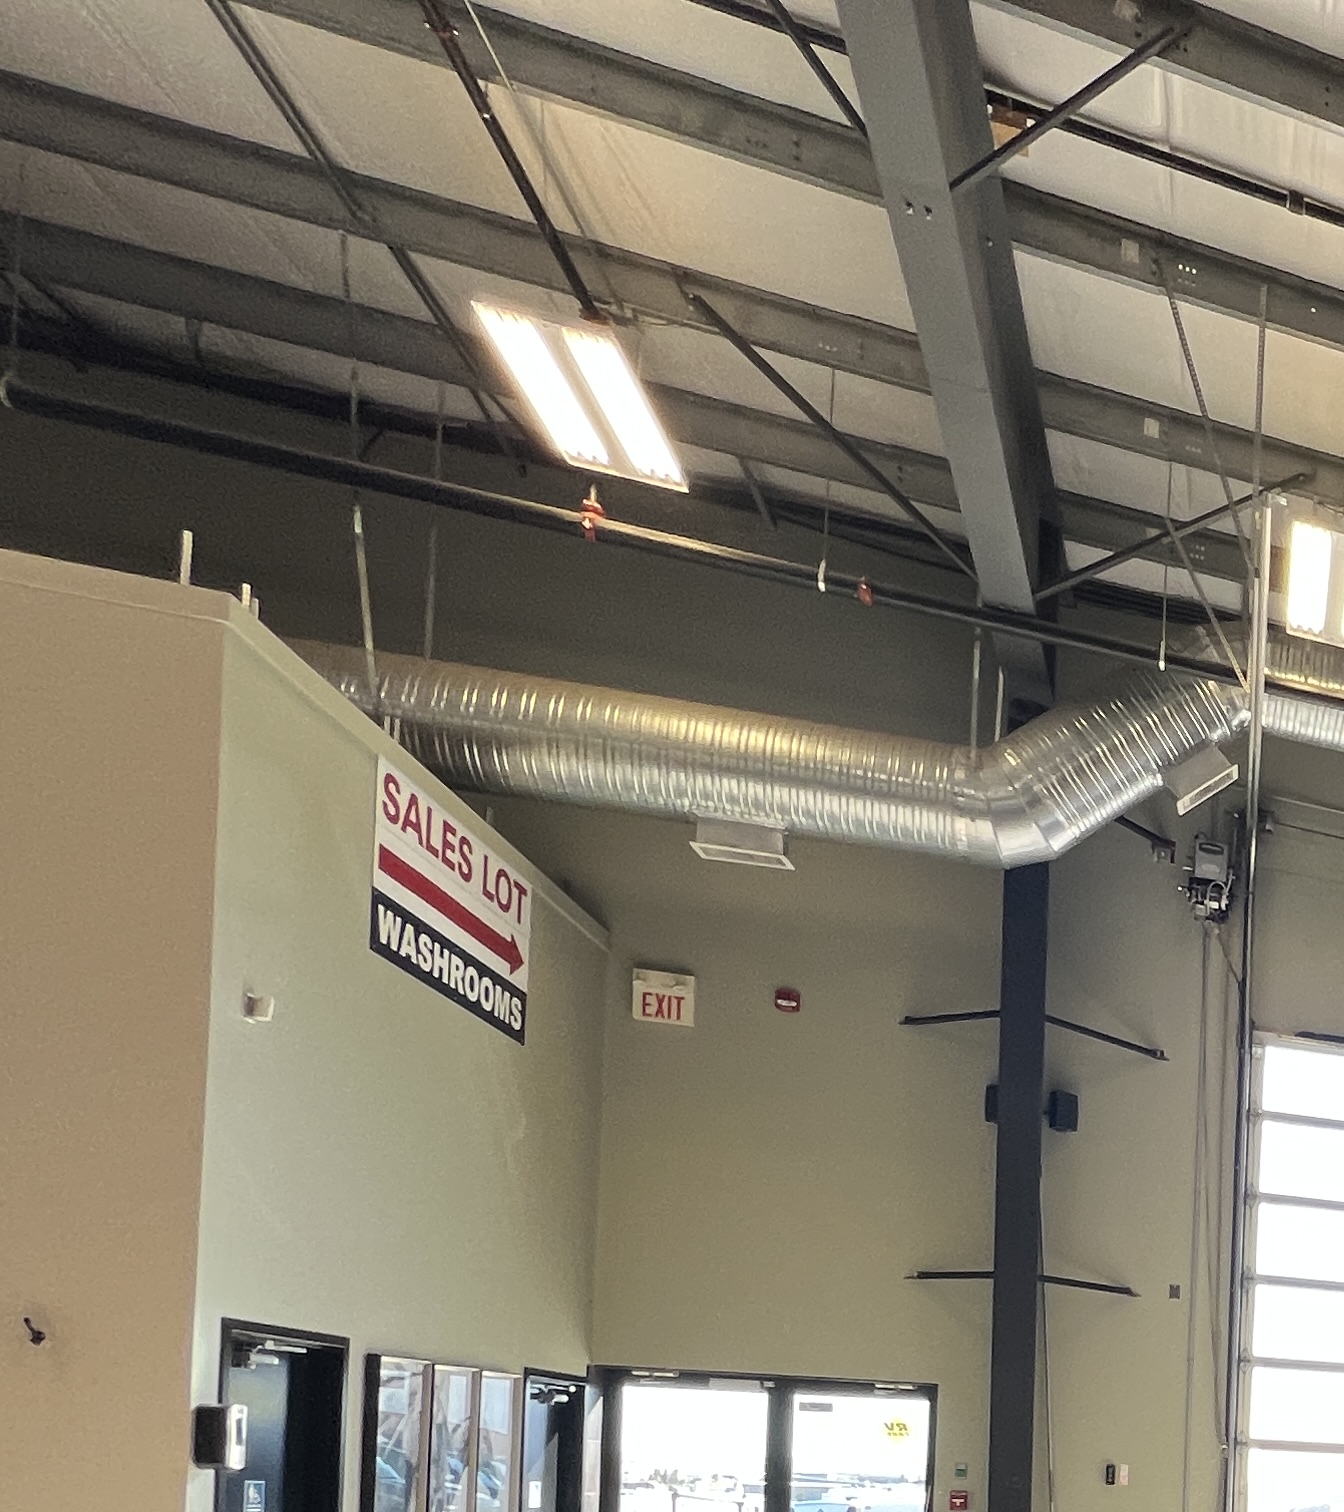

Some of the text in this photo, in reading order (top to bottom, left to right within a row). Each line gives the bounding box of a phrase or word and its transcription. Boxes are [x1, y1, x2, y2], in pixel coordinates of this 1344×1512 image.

[381, 772, 528, 925] SALES LOT
[377, 902, 523, 1032] WASHROOMS
[641, 991, 686, 1022] EXIT
